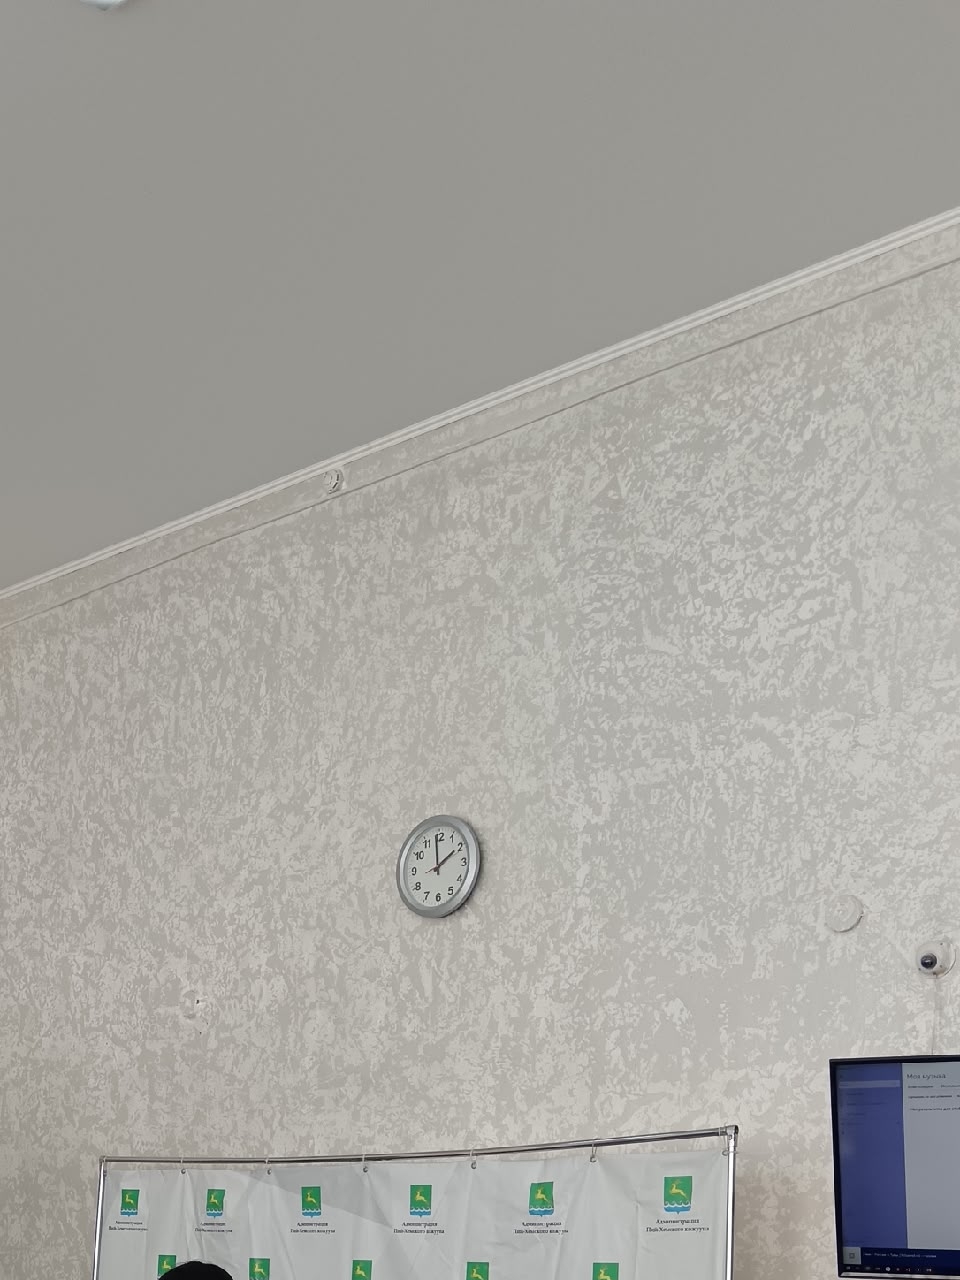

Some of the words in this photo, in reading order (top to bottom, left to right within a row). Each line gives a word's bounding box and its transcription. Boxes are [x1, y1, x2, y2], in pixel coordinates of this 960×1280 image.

[423, 840, 431, 849] 11
[457, 842, 463, 852] 2
[415, 851, 425, 861] 10
[461, 857, 467, 867] 3
[411, 866, 417, 876] 9
[456, 874, 462, 883] 4
[415, 882, 422, 891] 8
[447, 886, 454, 896] 5
[423, 891, 430, 901] 7
[435, 893, 442, 902] 6
